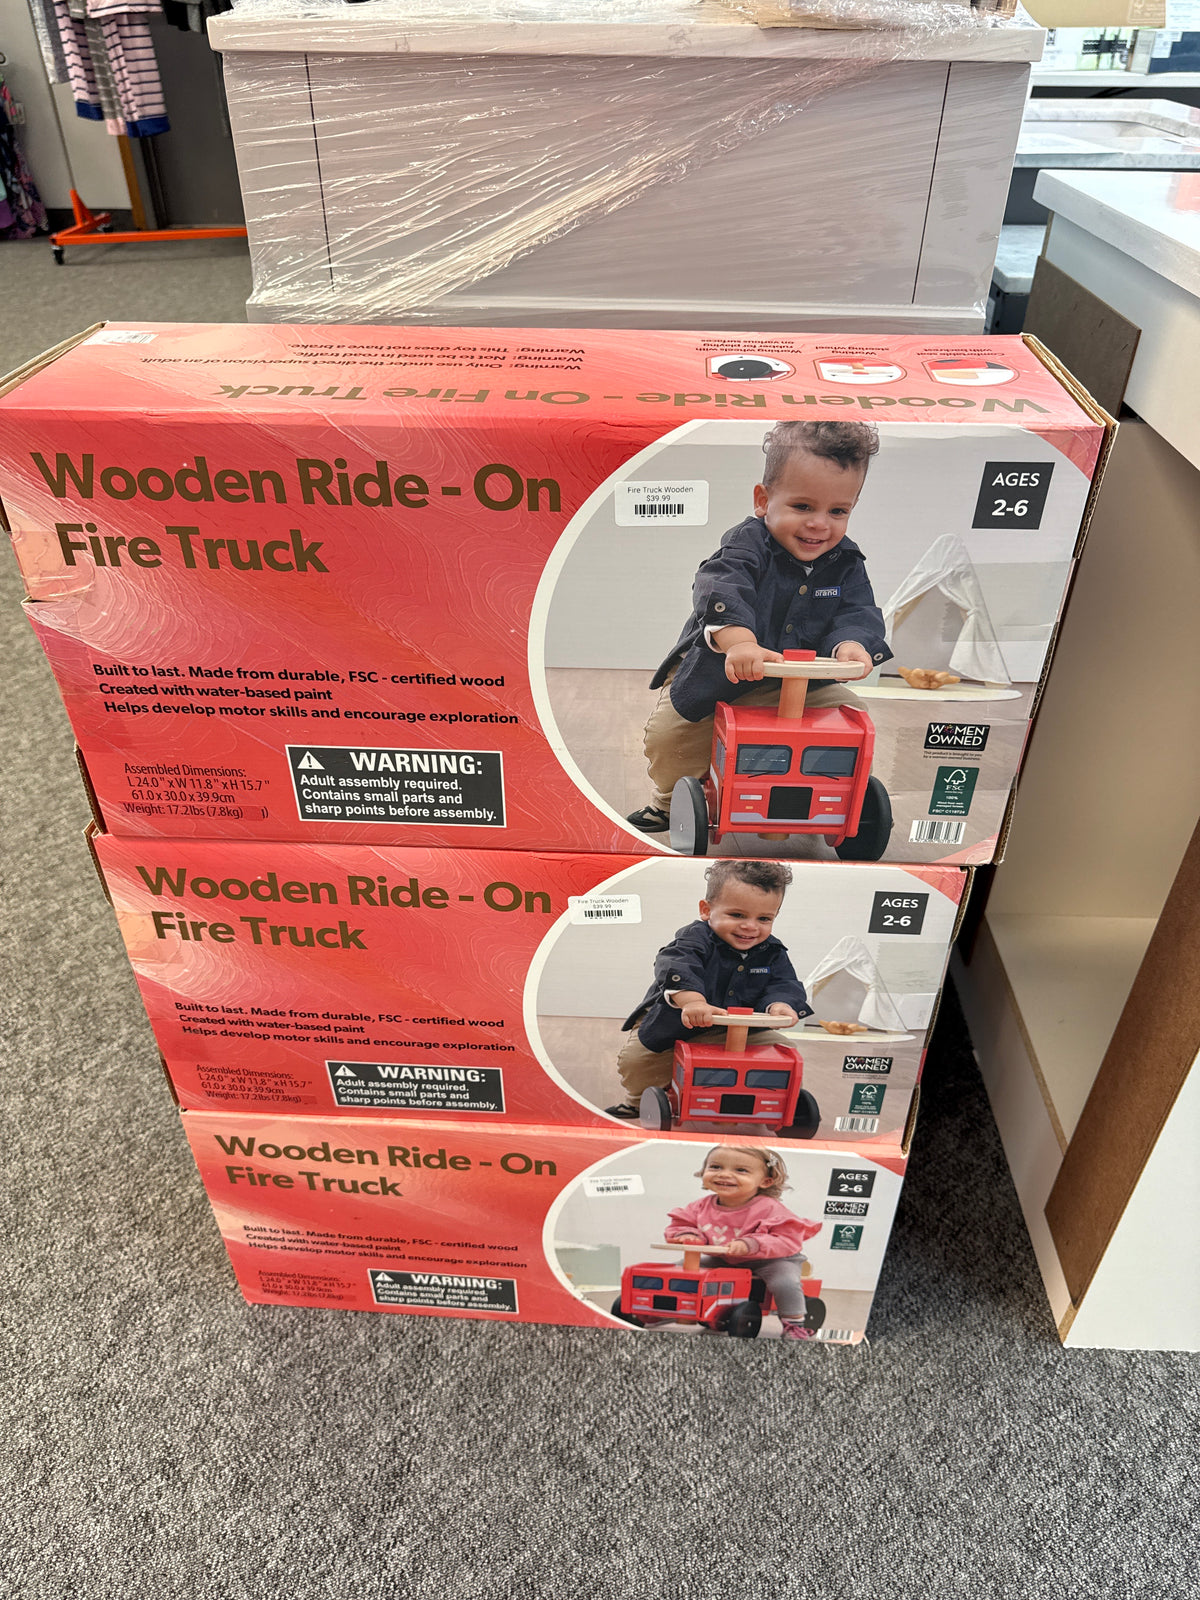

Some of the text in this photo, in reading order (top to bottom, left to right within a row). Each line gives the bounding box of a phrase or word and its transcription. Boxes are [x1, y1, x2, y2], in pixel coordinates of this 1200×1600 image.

[212, 385, 367, 400] Truck
[382, 388, 490, 403] Fire
[504, 390, 590, 405] On
[636, 392, 766, 408] Ride
[782, 394, 1052, 413] Wooden
[30, 452, 287, 504] Wooden
[296, 458, 429, 509] Ride
[473, 463, 562, 512] On
[992, 473, 1040, 486] AGES
[992, 499, 1029, 516] 2-6
[55, 523, 330, 573] Fire Truck
[93, 664, 130, 676] Built
[132, 666, 148, 676] to
[152, 665, 185, 677] last.
[189, 666, 234, 678] Made
[236, 668, 274, 679] from
[278, 669, 346, 684] durable,
[349, 671, 378, 682] FSC
[391, 674, 456, 685] certified
[460, 676, 504, 686] wood
[99, 683, 332, 701] Created with water-based paint
[104, 702, 518, 724] Helps develop motor skills and encourage exploration
[928, 734, 982, 746] OWNED
[124, 763, 247, 777] Assembled Dimensions:
[349, 752, 483, 775] WARNING:
[300, 774, 462, 791] Adult assembly required.
[132, 790, 154, 800] 61.0
[166, 791, 187, 801] 30.0
[197, 792, 235, 803] 39.9cm
[302, 789, 463, 804] Contains small parts and
[123, 802, 244, 819] Weight: 17.2lbs (7.8kg)
[305, 803, 497, 822] sharp points before assembly.
[135, 866, 338, 904] Wooden
[347, 875, 450, 909] Ride
[483, 881, 552, 913] On
[881, 898, 918, 908] AGES
[882, 915, 912, 926] 2-6
[151, 910, 368, 950] Fire Truck
[175, 1002, 203, 1012] Built
[222, 1006, 248, 1014] last.
[251, 1008, 286, 1017] Made
[289, 1010, 319, 1019] from
[322, 1012, 376, 1023] durable,
[379, 1014, 402, 1022] FSC
[412, 1016, 465, 1025] certified
[468, 1019, 504, 1027] wood
[179, 1015, 365, 1034] Created with water-based paint
[182, 1026, 218, 1036] Helps
[220, 1029, 270, 1040] develop
[273, 1033, 311, 1042] motor
[313, 1036, 344, 1044] skills
[373, 1039, 440, 1049] encourage
[442, 1042, 515, 1051] exploration
[377, 1066, 486, 1082] WARNING:
[336, 1079, 469, 1092] Adult assembly required.
[338, 1087, 386, 1095] Contains
[340, 1096, 370, 1104] sharp
[373, 1097, 407, 1105] points
[445, 1100, 498, 1110] assembly.
[214, 1135, 379, 1165] Wooden
[387, 1146, 472, 1171] Ride
[500, 1152, 557, 1176] On
[225, 1166, 404, 1196] Fire Truck
[839, 1184, 863, 1192] 2-6
[410, 1274, 502, 1290] WARNING:
